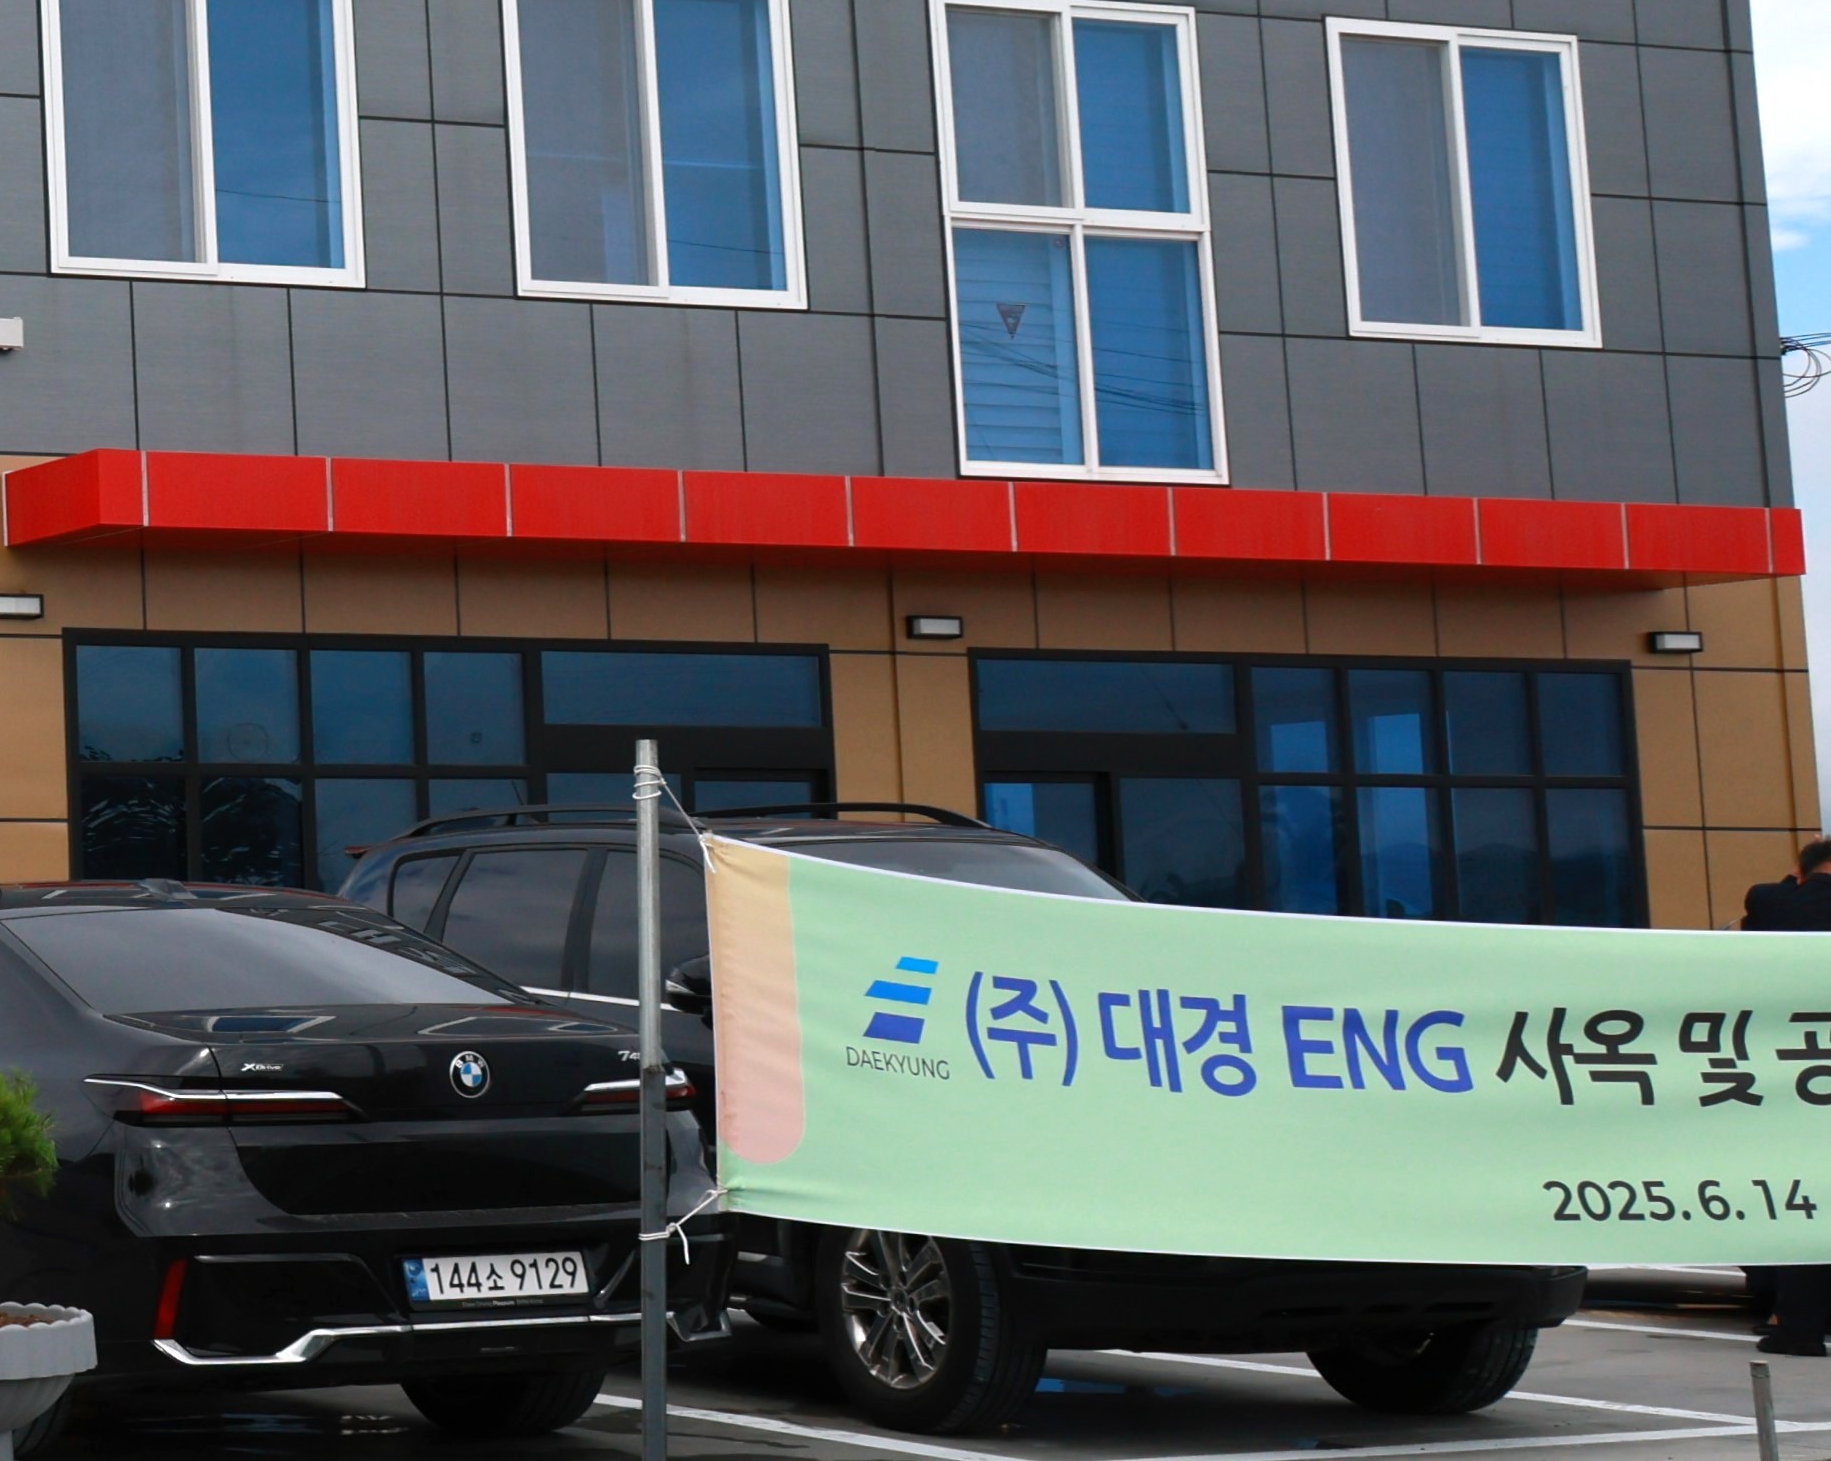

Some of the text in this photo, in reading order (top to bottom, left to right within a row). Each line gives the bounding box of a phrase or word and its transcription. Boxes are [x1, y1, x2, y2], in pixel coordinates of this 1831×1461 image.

[966, 971, 1078, 1087] (주)
[1098, 988, 1257, 1097] 대경
[1282, 1005, 1474, 1093] ENG
[1495, 1007, 1658, 1106] 사옥
[1678, 1009, 1764, 1108] 및
[455, 1053, 484, 1068] BMW
[845, 1045, 950, 1080] DAEKYUNG
[1543, 1179, 1818, 1222] 2025.6.14
[429, 1256, 578, 1295] 144소 9129
